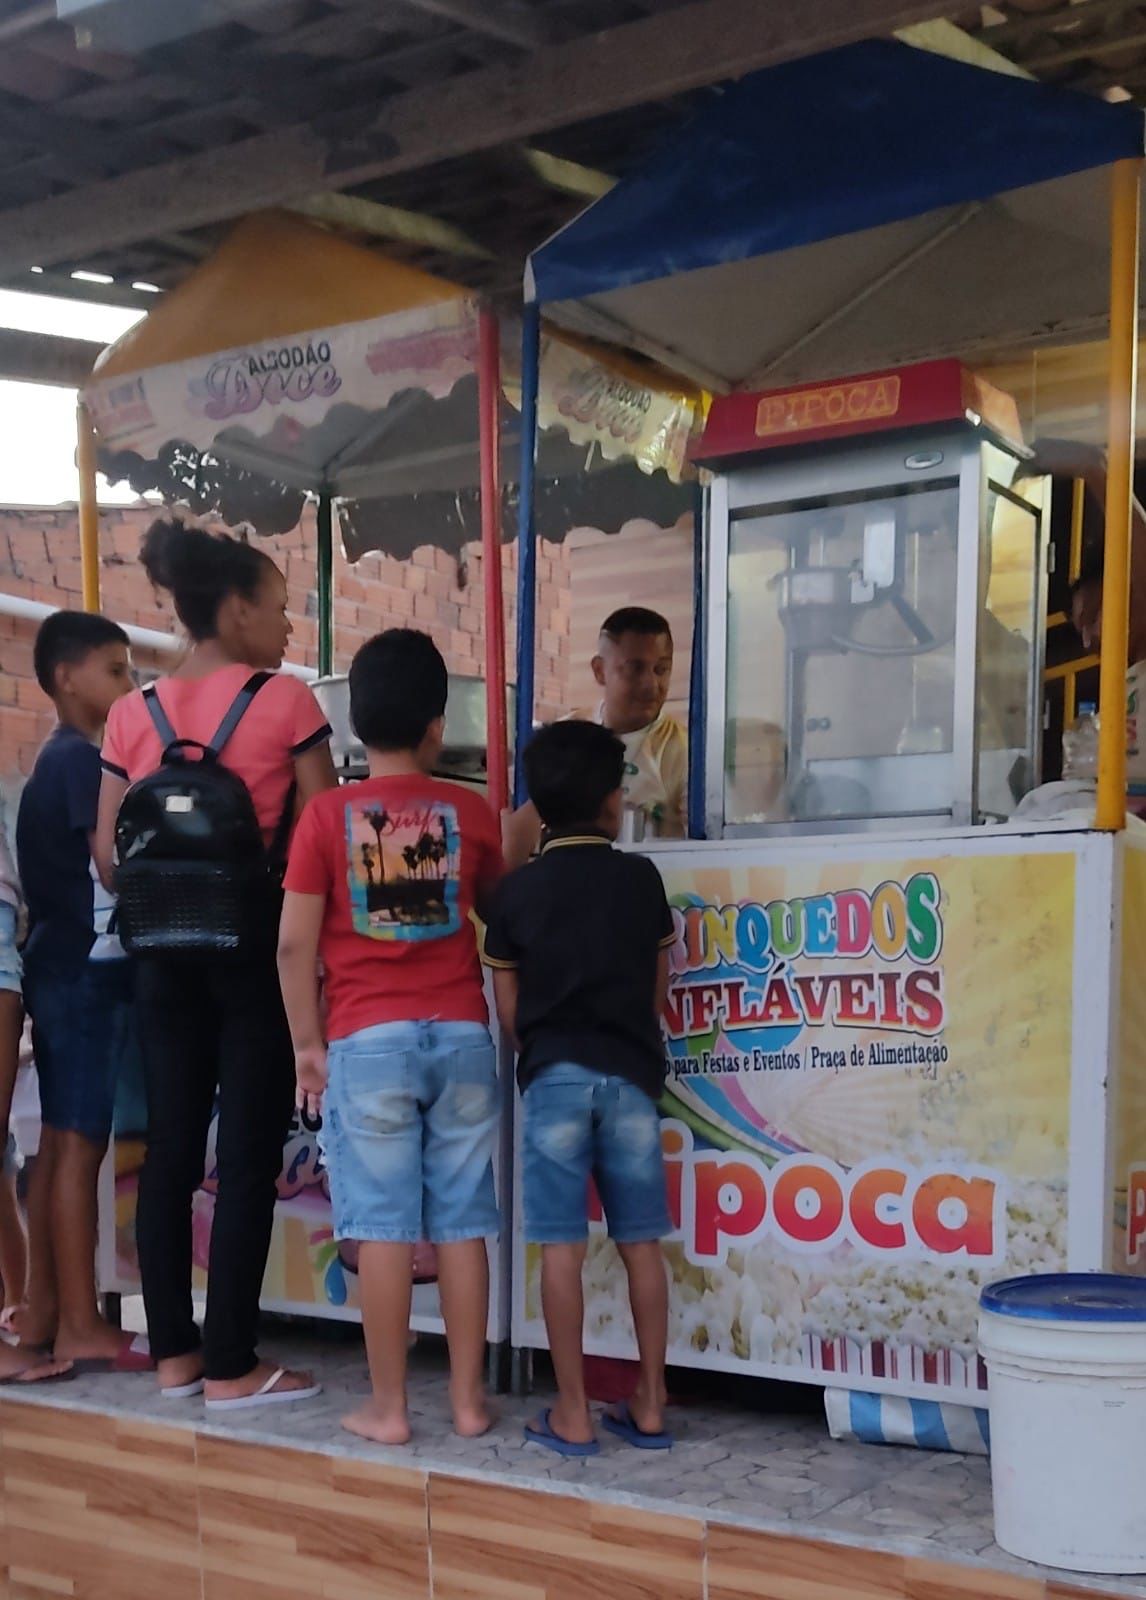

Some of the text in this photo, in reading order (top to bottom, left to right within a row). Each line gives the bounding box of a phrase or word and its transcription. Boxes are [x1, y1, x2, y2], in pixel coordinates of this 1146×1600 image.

[764, 384, 890, 430] PIPOCA
[661, 961, 945, 1036] NFLÁVEIS
[674, 1056, 699, 1081] para
[702, 1051, 740, 1074] Festas
[743, 1056, 750, 1072] e
[753, 1048, 800, 1071] Eventos
[811, 1046, 846, 1074] Praça
[851, 1045, 865, 1067] de
[868, 1039, 948, 1069] Alimentação
[588, 1129, 997, 1256] ipoca
